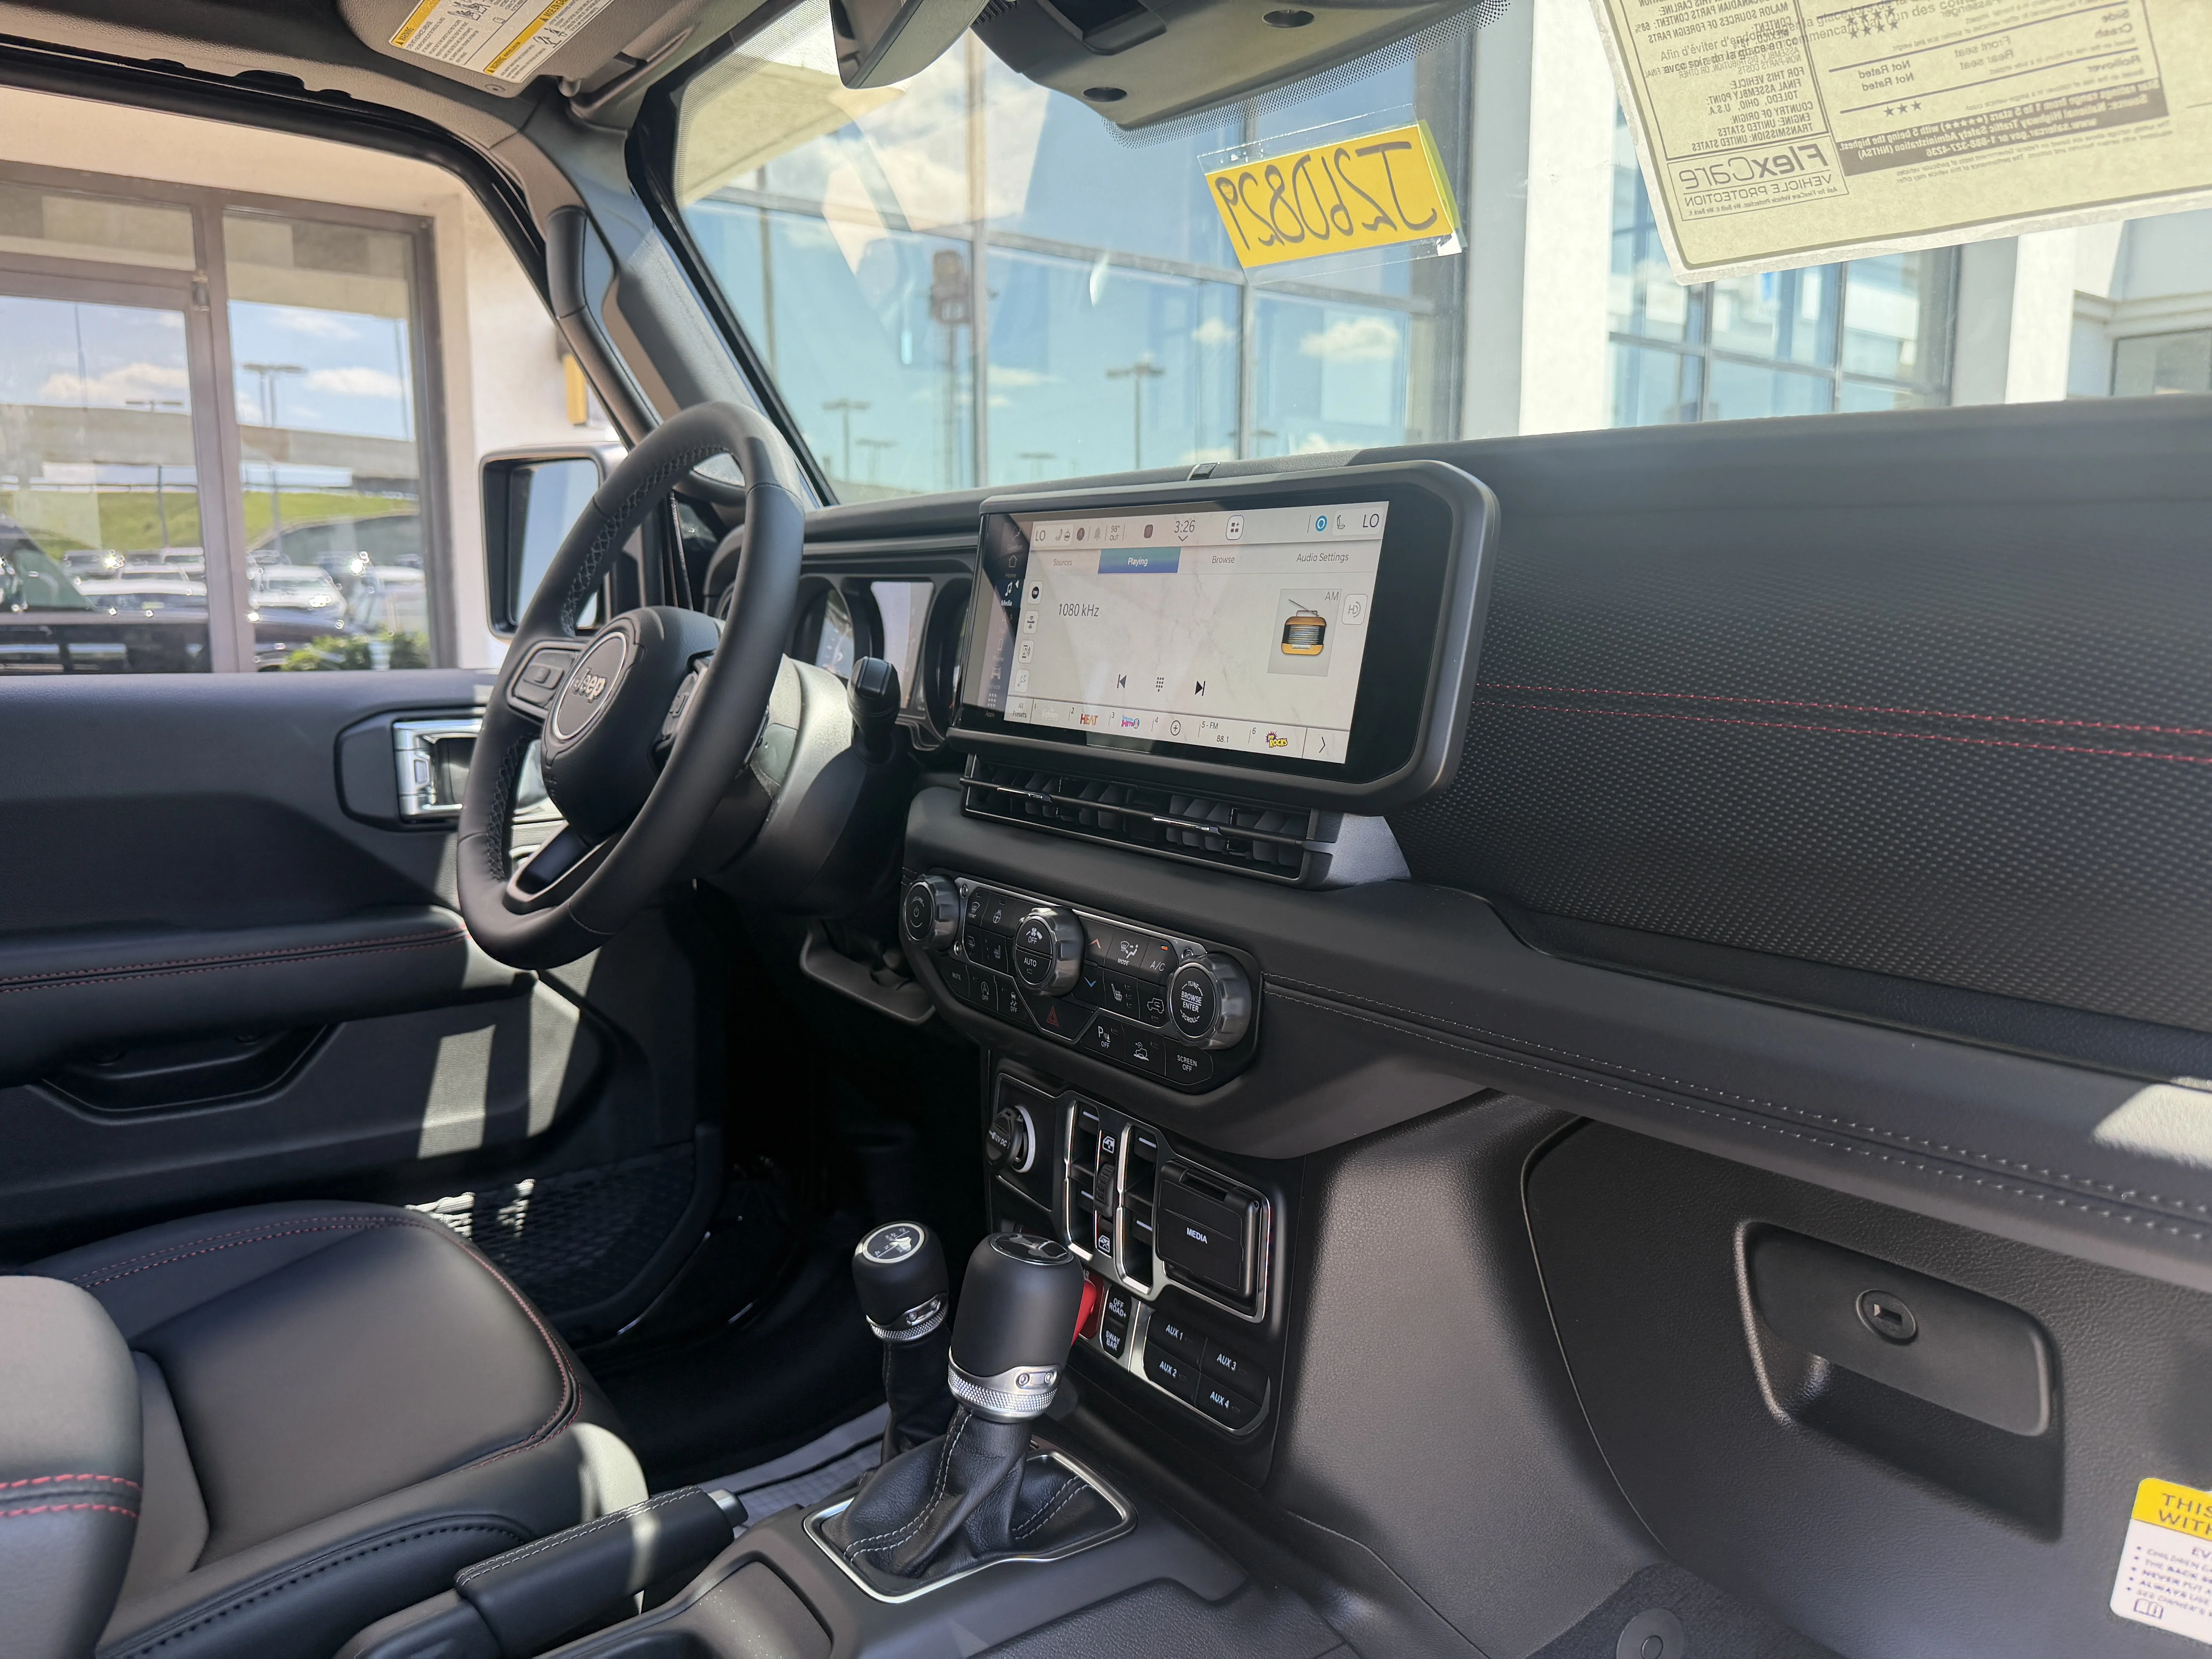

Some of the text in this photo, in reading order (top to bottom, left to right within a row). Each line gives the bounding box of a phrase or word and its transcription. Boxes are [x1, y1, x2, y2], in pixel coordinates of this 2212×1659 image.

[1910, 2, 1937, 17] des
[1658, 38, 1721, 62] Afin d'éviter
[1174, 520, 1195, 534] 3:26
[1362, 514, 1379, 528] LO
[1036, 530, 1046, 541] LO
[1128, 557, 1148, 567] Playing
[1212, 556, 1235, 564] Browse
[1297, 553, 1349, 563] Audio Settings
[1325, 591, 1339, 601] AM
[1058, 603, 1099, 617] 1080 kHz
[572, 667, 608, 703] Jeep
[1080, 713, 1098, 726] HEAT
[1216, 735, 1229, 743] 88.1
[1028, 937, 1037, 945] OFF
[1024, 958, 1037, 967] AUTO
[1117, 958, 1129, 966] MODE
[1150, 960, 1165, 972] A/C
[1188, 981, 1199, 989] TUNE
[1181, 991, 1202, 1004] BROWSE
[1182, 1002, 1199, 1013] ENTER
[1181, 1012, 1199, 1023] SCROLL
[1101, 1041, 1110, 1049] OFF
[1177, 1055, 1197, 1067] SCREEN
[1182, 1064, 1192, 1072] OFF
[1186, 1227, 1207, 1244] MEDIA
[1113, 1297, 1124, 1308] OFF
[1105, 1330, 1120, 1344] SWAY
[1166, 1324, 1183, 1341] AUX 1
[1106, 1338, 1118, 1351] BAR
[1217, 1353, 1237, 1372] AUX 3
[1159, 1360, 1177, 1379] AUX 2
[1210, 1391, 1230, 1409] AUX 4
[2162, 1493, 2212, 1518] THIS
